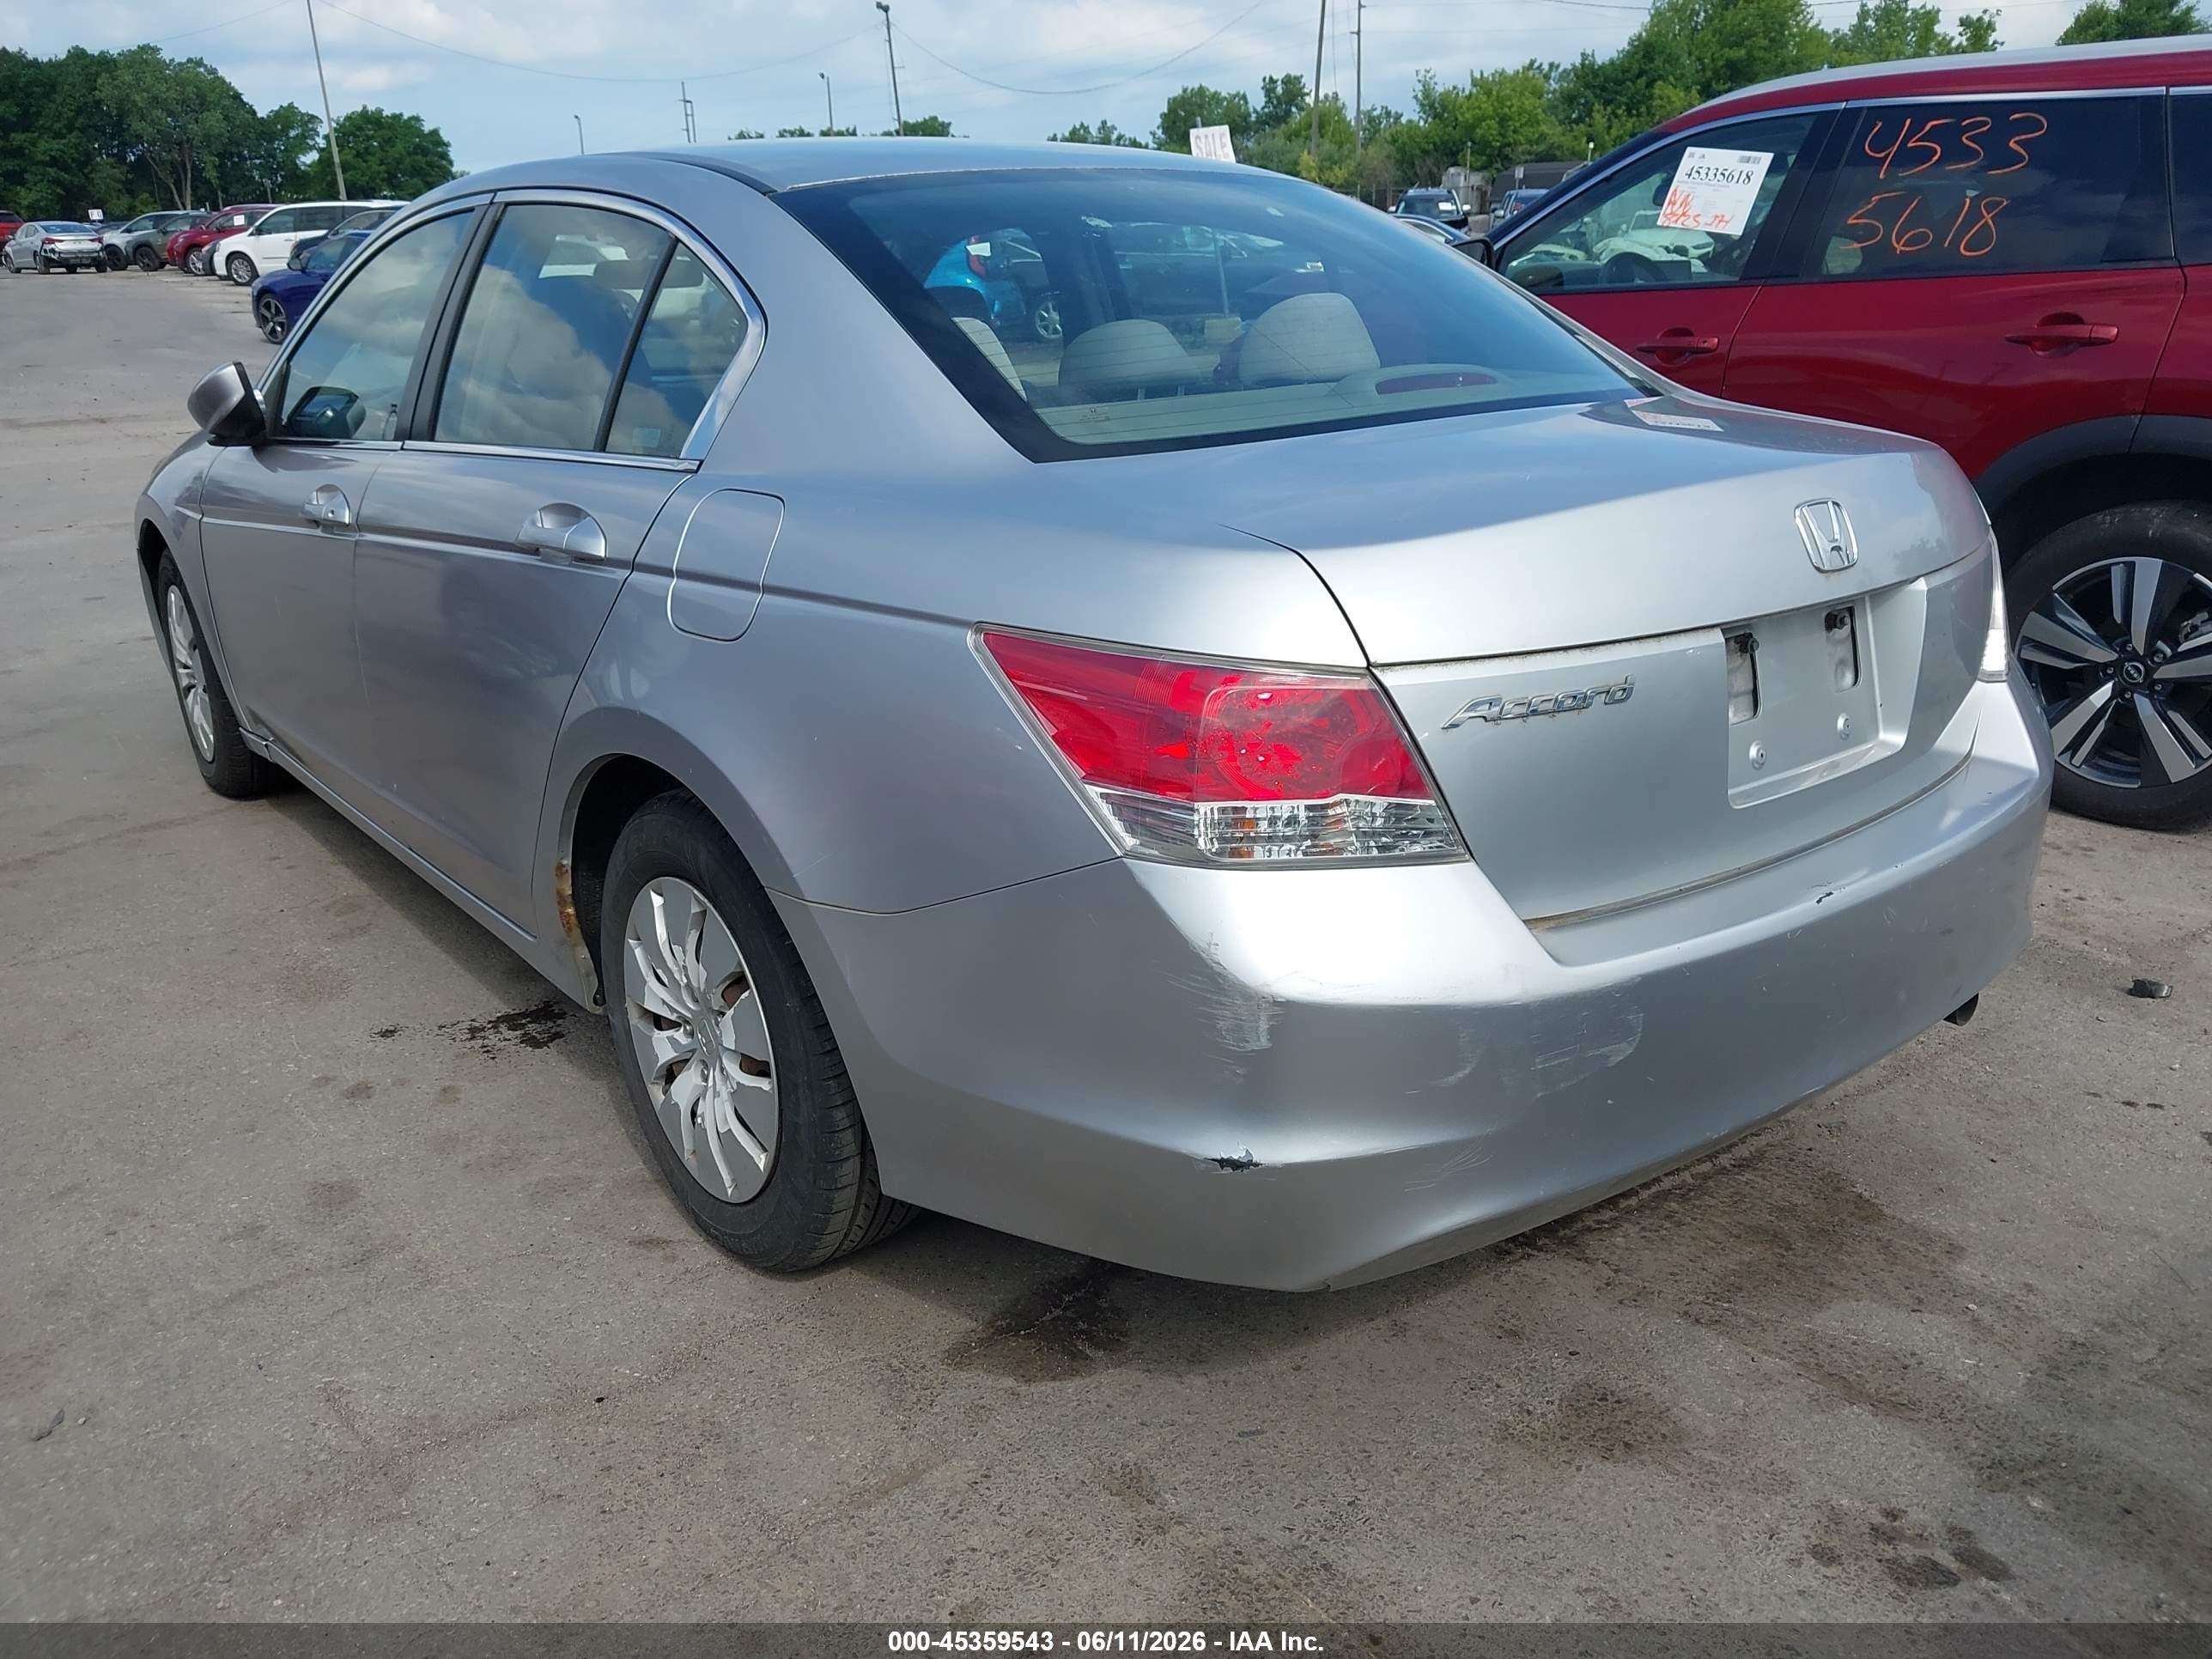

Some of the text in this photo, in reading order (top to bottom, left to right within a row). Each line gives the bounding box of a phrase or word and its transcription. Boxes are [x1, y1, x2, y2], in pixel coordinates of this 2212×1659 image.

[1684, 164, 1753, 185] 45335618
[1864, 112, 2048, 179] 4533
[1841, 191, 2011, 257] 5618
[1440, 673, 1636, 730] Accord
